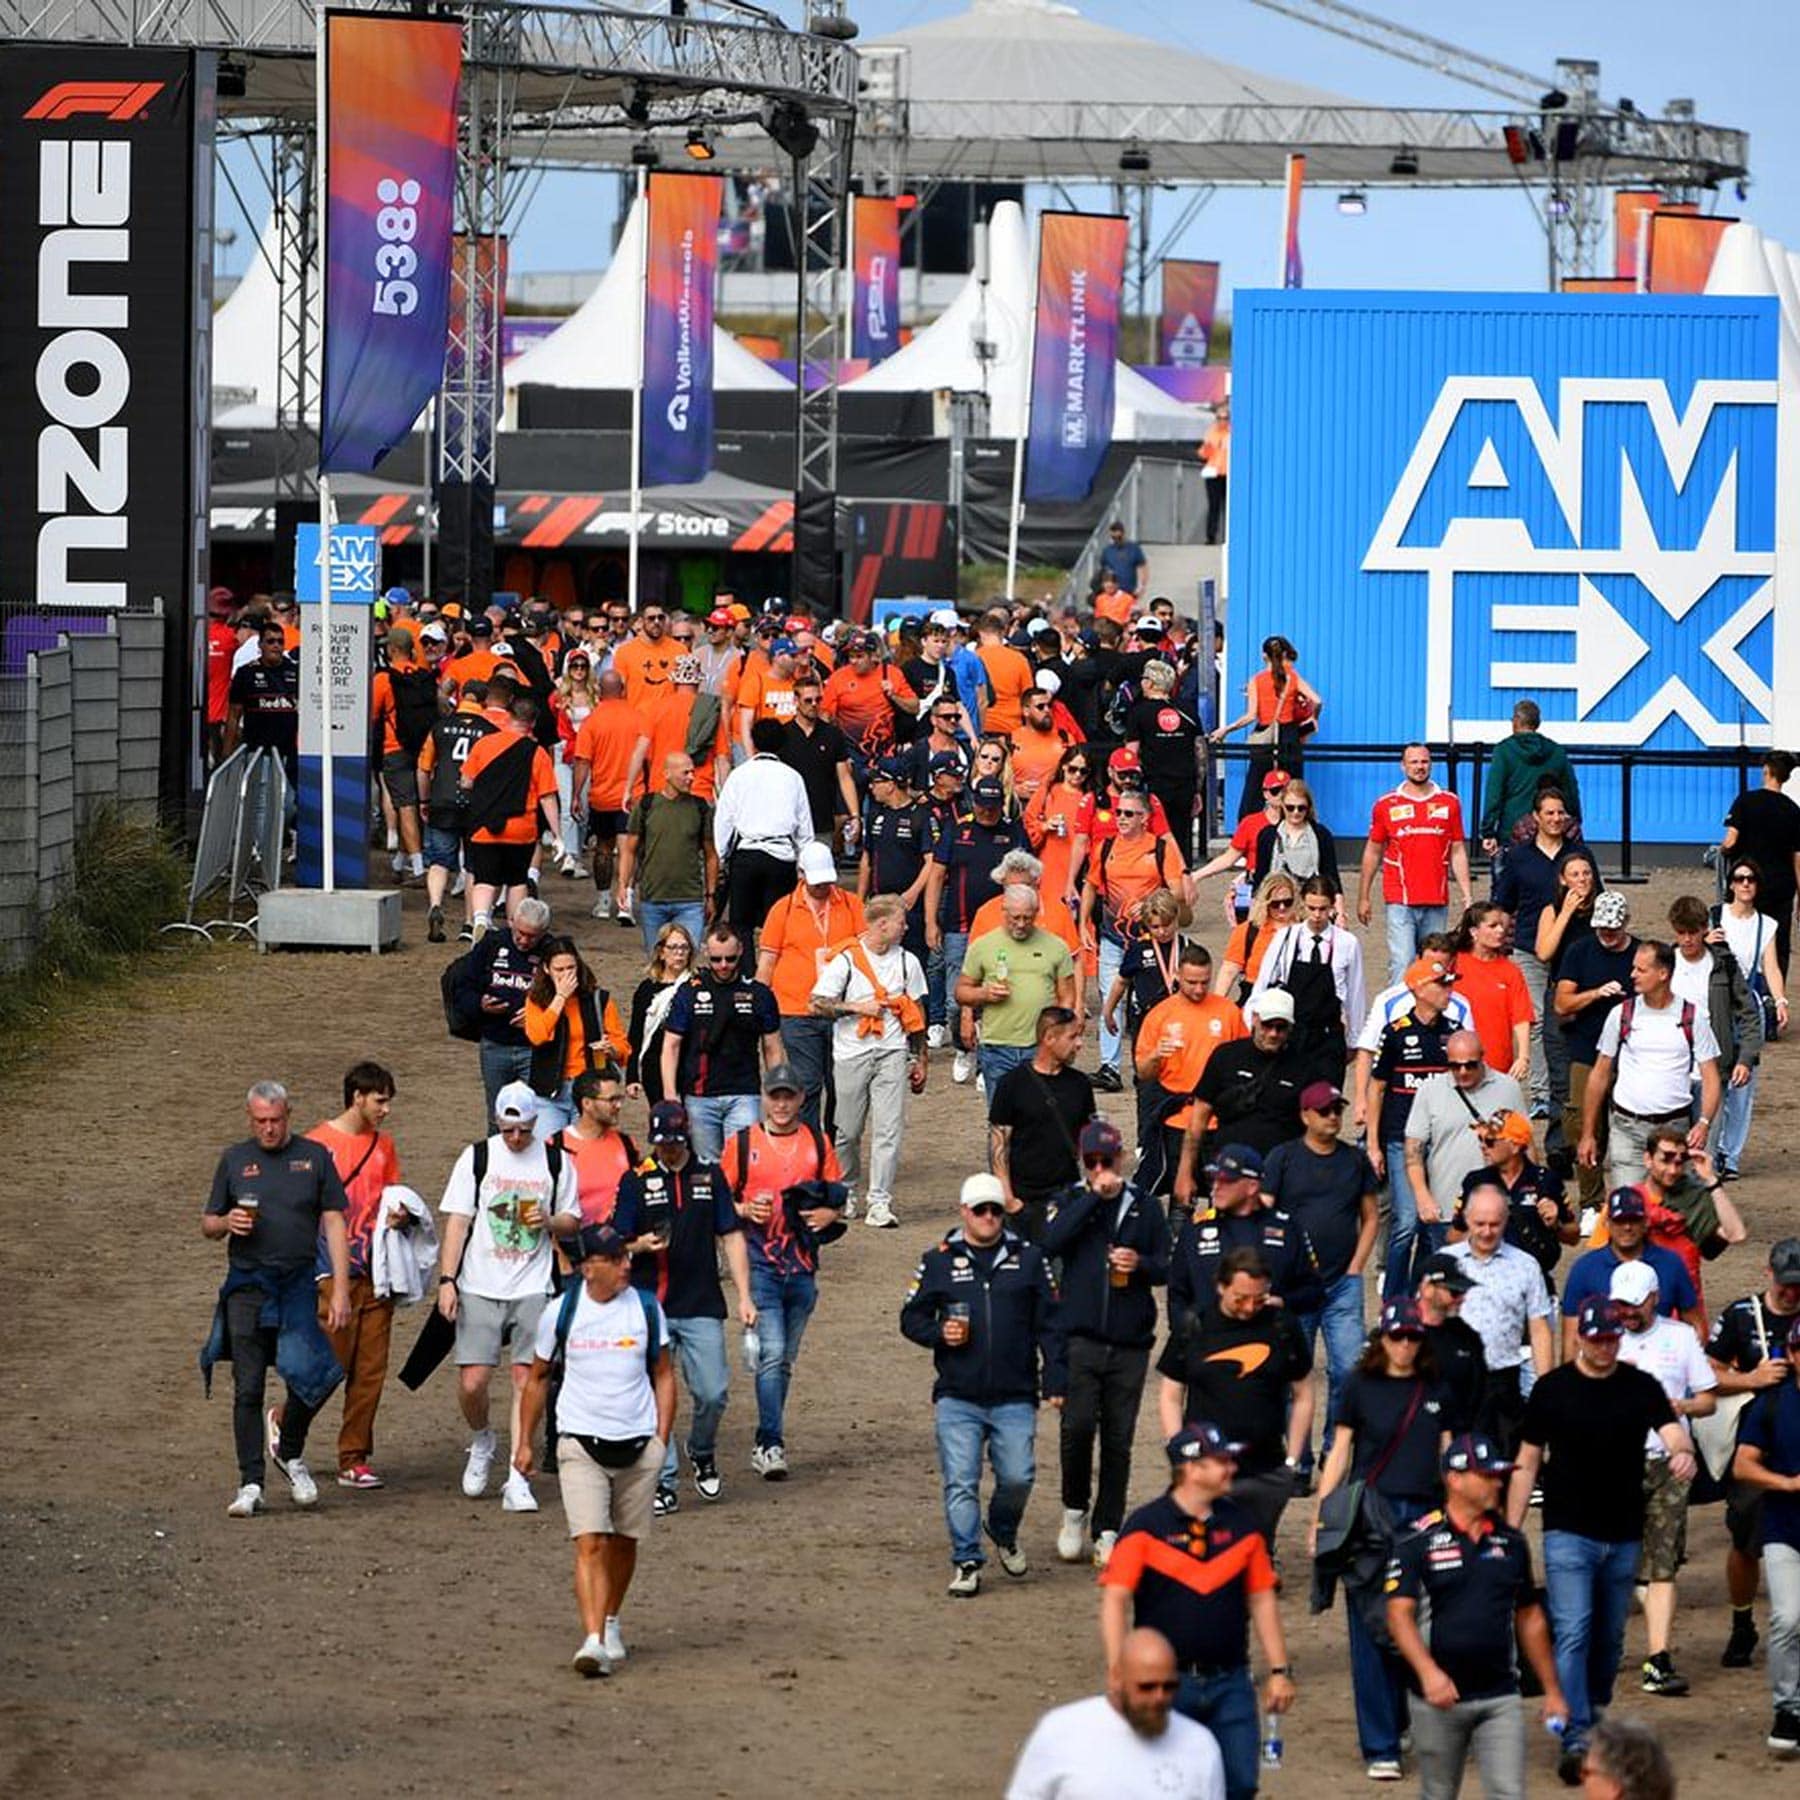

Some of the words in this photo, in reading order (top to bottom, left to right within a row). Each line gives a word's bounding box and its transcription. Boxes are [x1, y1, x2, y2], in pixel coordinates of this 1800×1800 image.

[22, 81, 166, 120] F1
[1067, 270, 1088, 412] MARKTLINK
[656, 512, 729, 536] Store
[451, 736, 470, 764] 4
